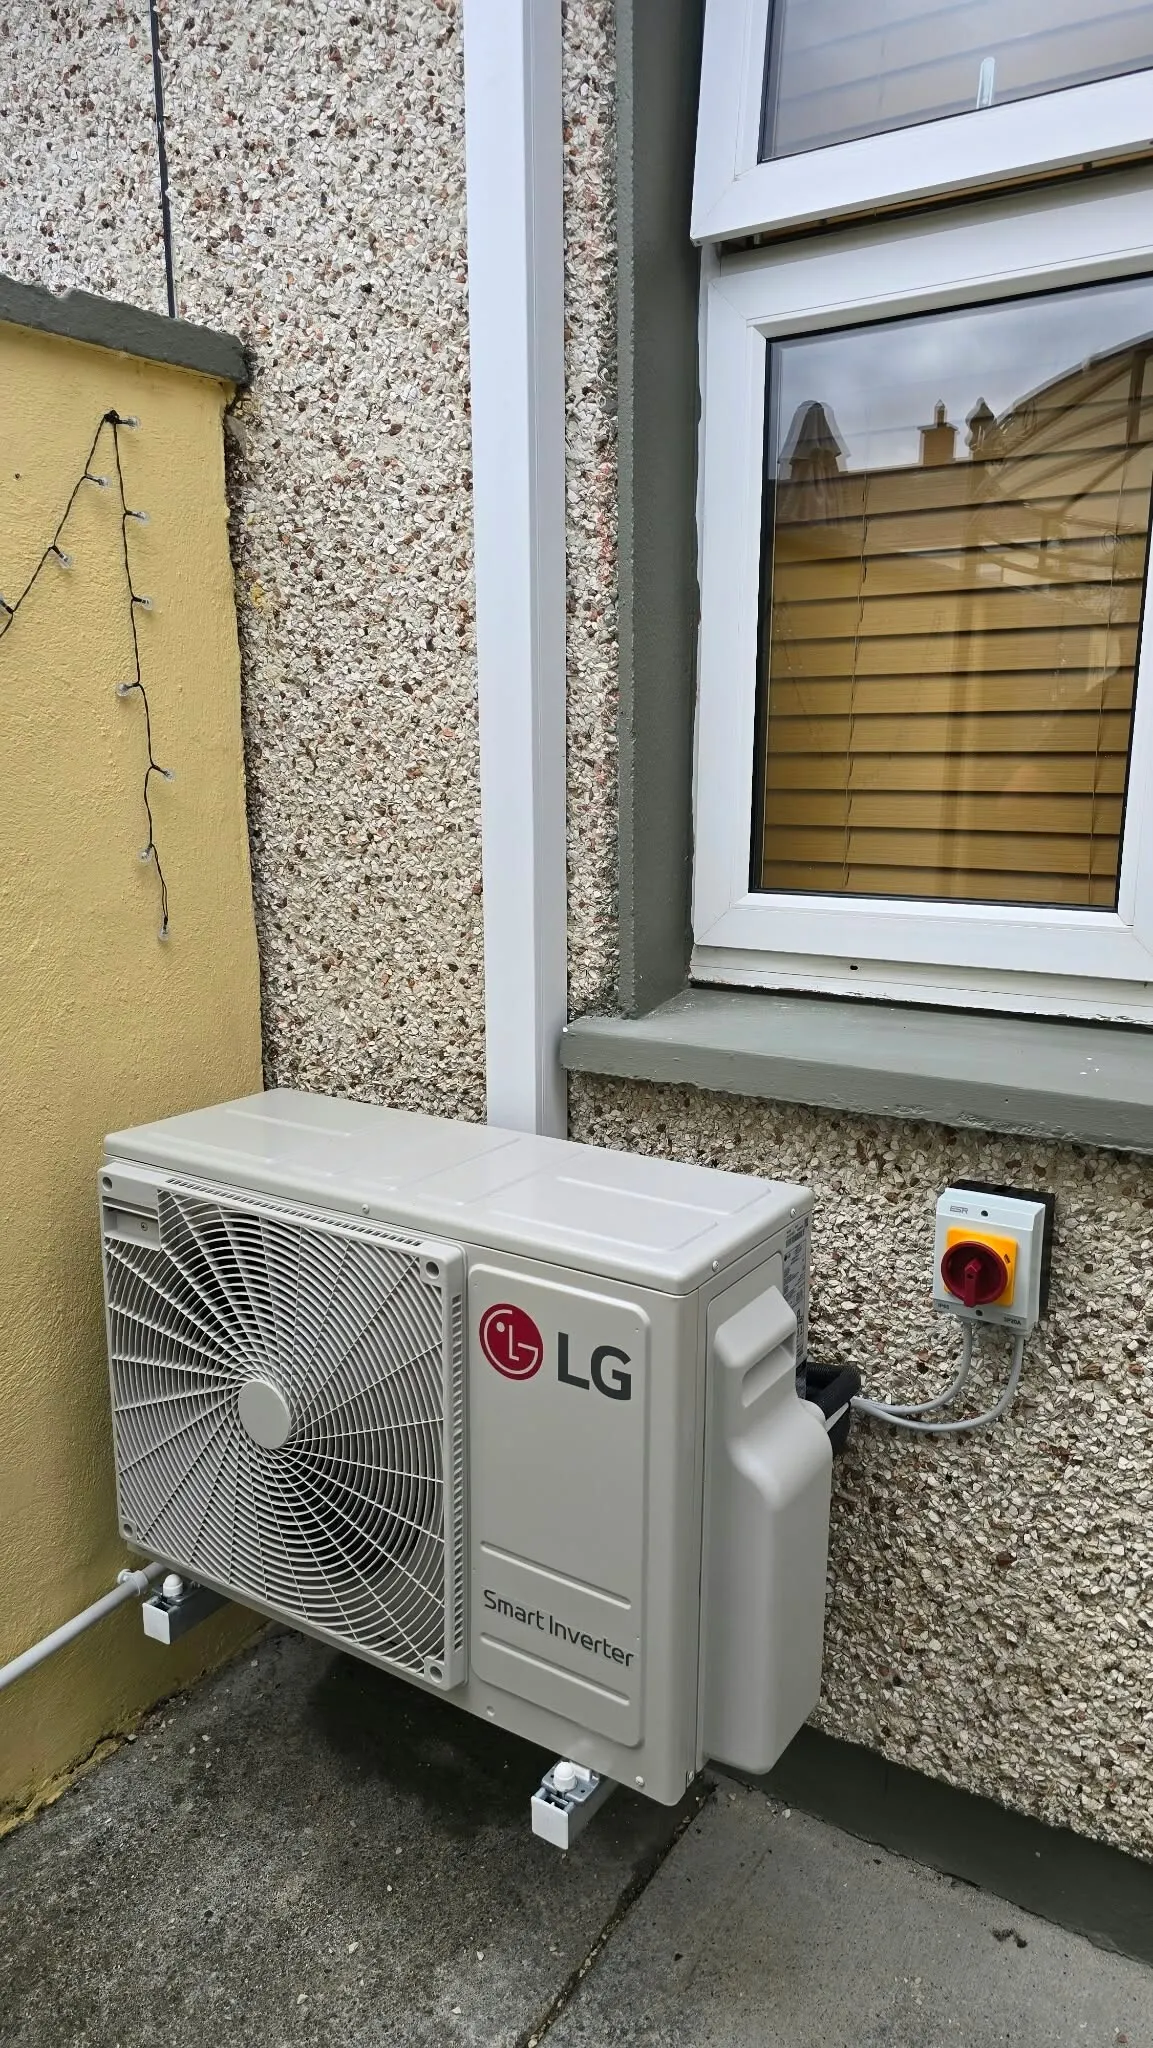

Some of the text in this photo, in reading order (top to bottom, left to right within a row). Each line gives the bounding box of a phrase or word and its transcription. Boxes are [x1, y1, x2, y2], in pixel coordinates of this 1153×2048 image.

[558, 1332, 632, 1401] LG
[483, 1589, 634, 1667] Smart Inverter
